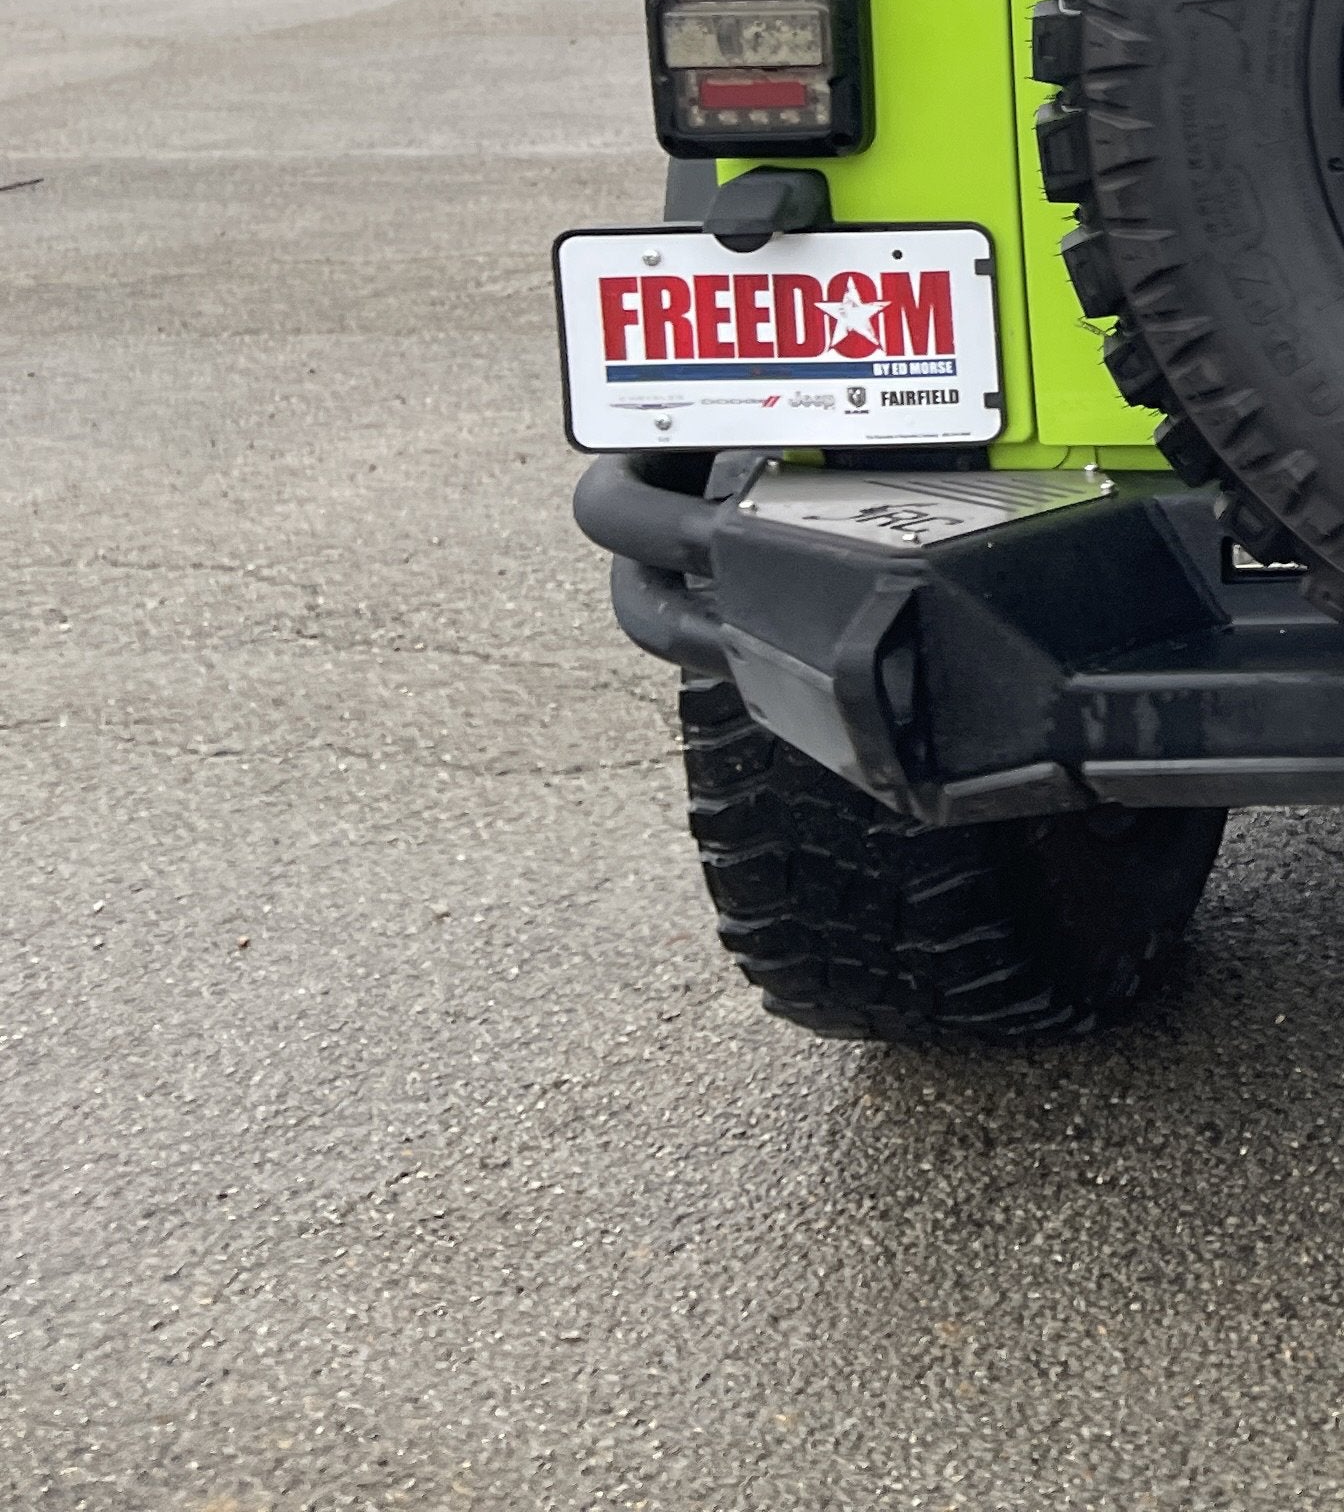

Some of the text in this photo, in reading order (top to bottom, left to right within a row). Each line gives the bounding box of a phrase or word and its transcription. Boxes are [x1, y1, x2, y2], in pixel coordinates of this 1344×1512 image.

[599, 270, 955, 361] FREEDOM
[873, 361, 953, 376] BY ED MORSE
[788, 391, 835, 410] Jeep
[881, 389, 959, 406] FAIRFIELD
